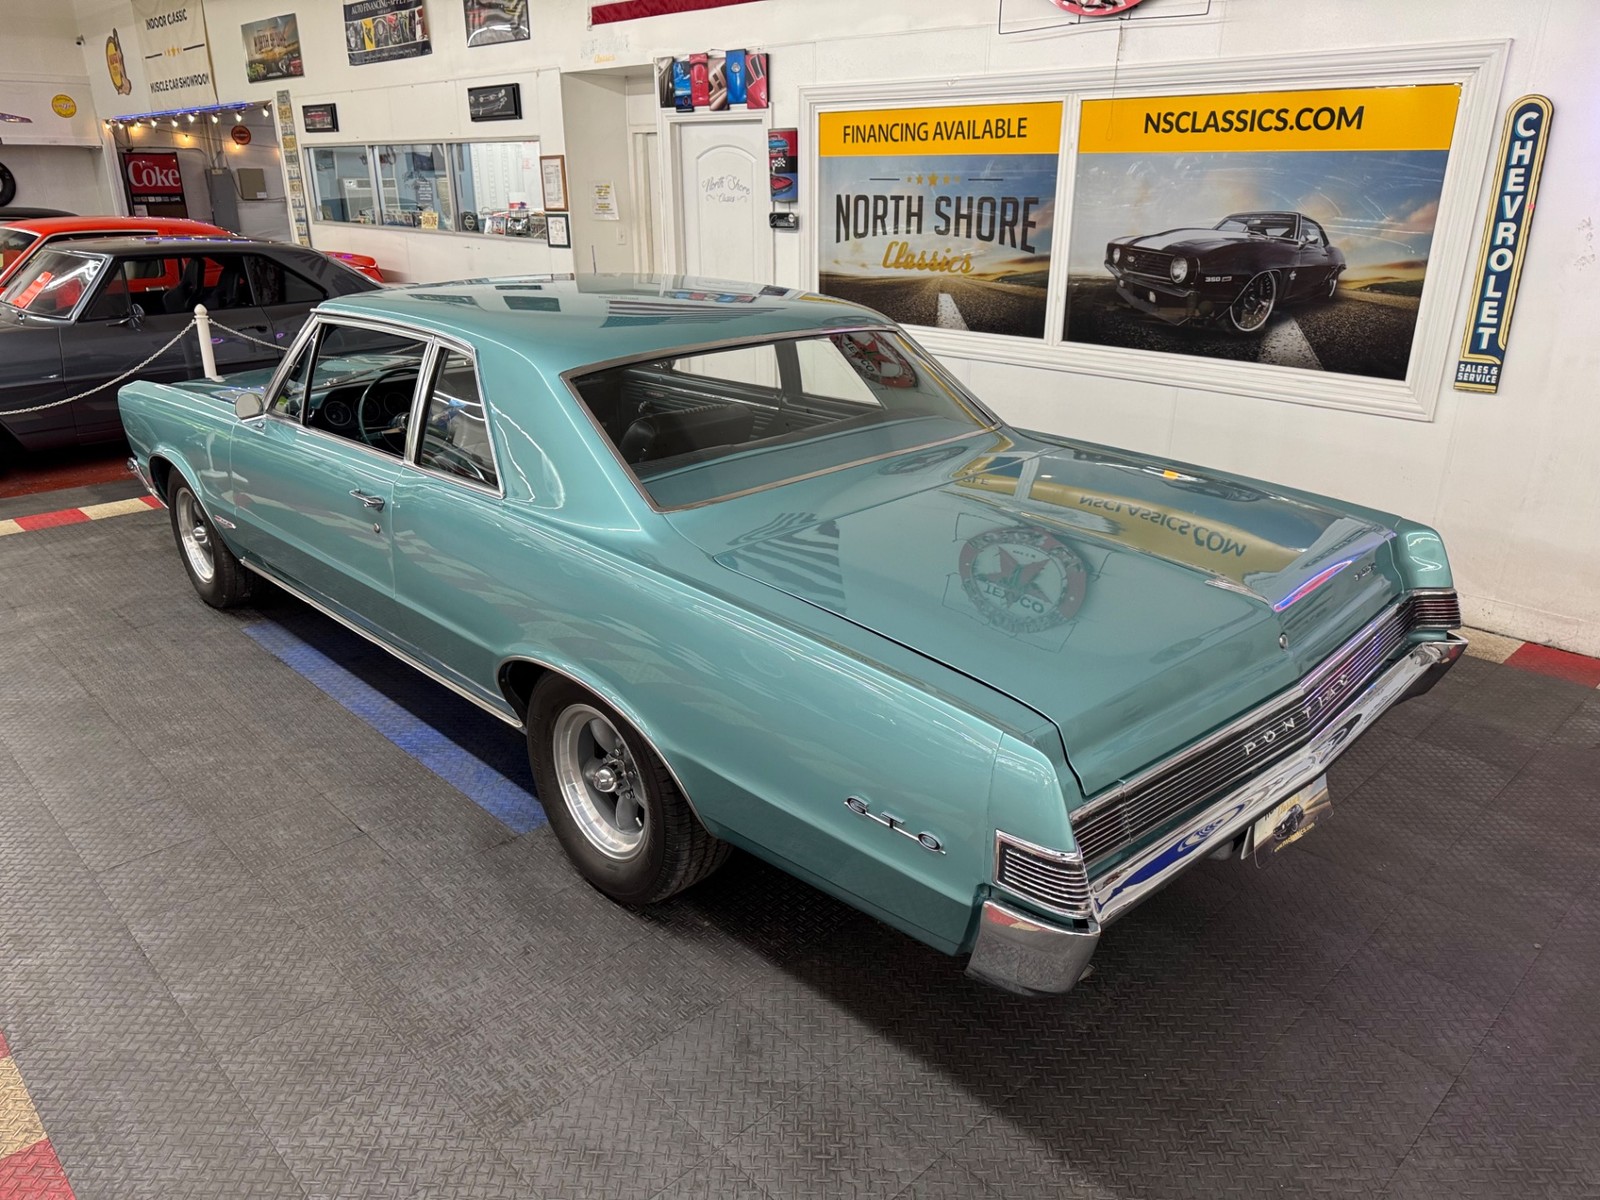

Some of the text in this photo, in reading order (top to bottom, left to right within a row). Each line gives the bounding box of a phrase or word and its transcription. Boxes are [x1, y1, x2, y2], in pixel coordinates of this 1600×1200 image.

[145, 8, 188, 30] INDOOR CLASSIC
[150, 73, 210, 93] MUSCLE CAR SHOWROOM
[843, 117, 1028, 143] FINANCING AVAILABLE
[1143, 105, 1365, 133] NSCLASSICS.COM
[127, 160, 181, 187] Coke
[836, 193, 1039, 254] NORTH SHORE
[1475, 111, 1539, 350] CHEVROLET
[881, 240, 975, 274] Classics
[1457, 371, 1497, 384] SERVICE
[1459, 363, 1498, 375] SALES &
[1243, 674, 1348, 755] PONTIAC
[844, 795, 946, 855] GTO
